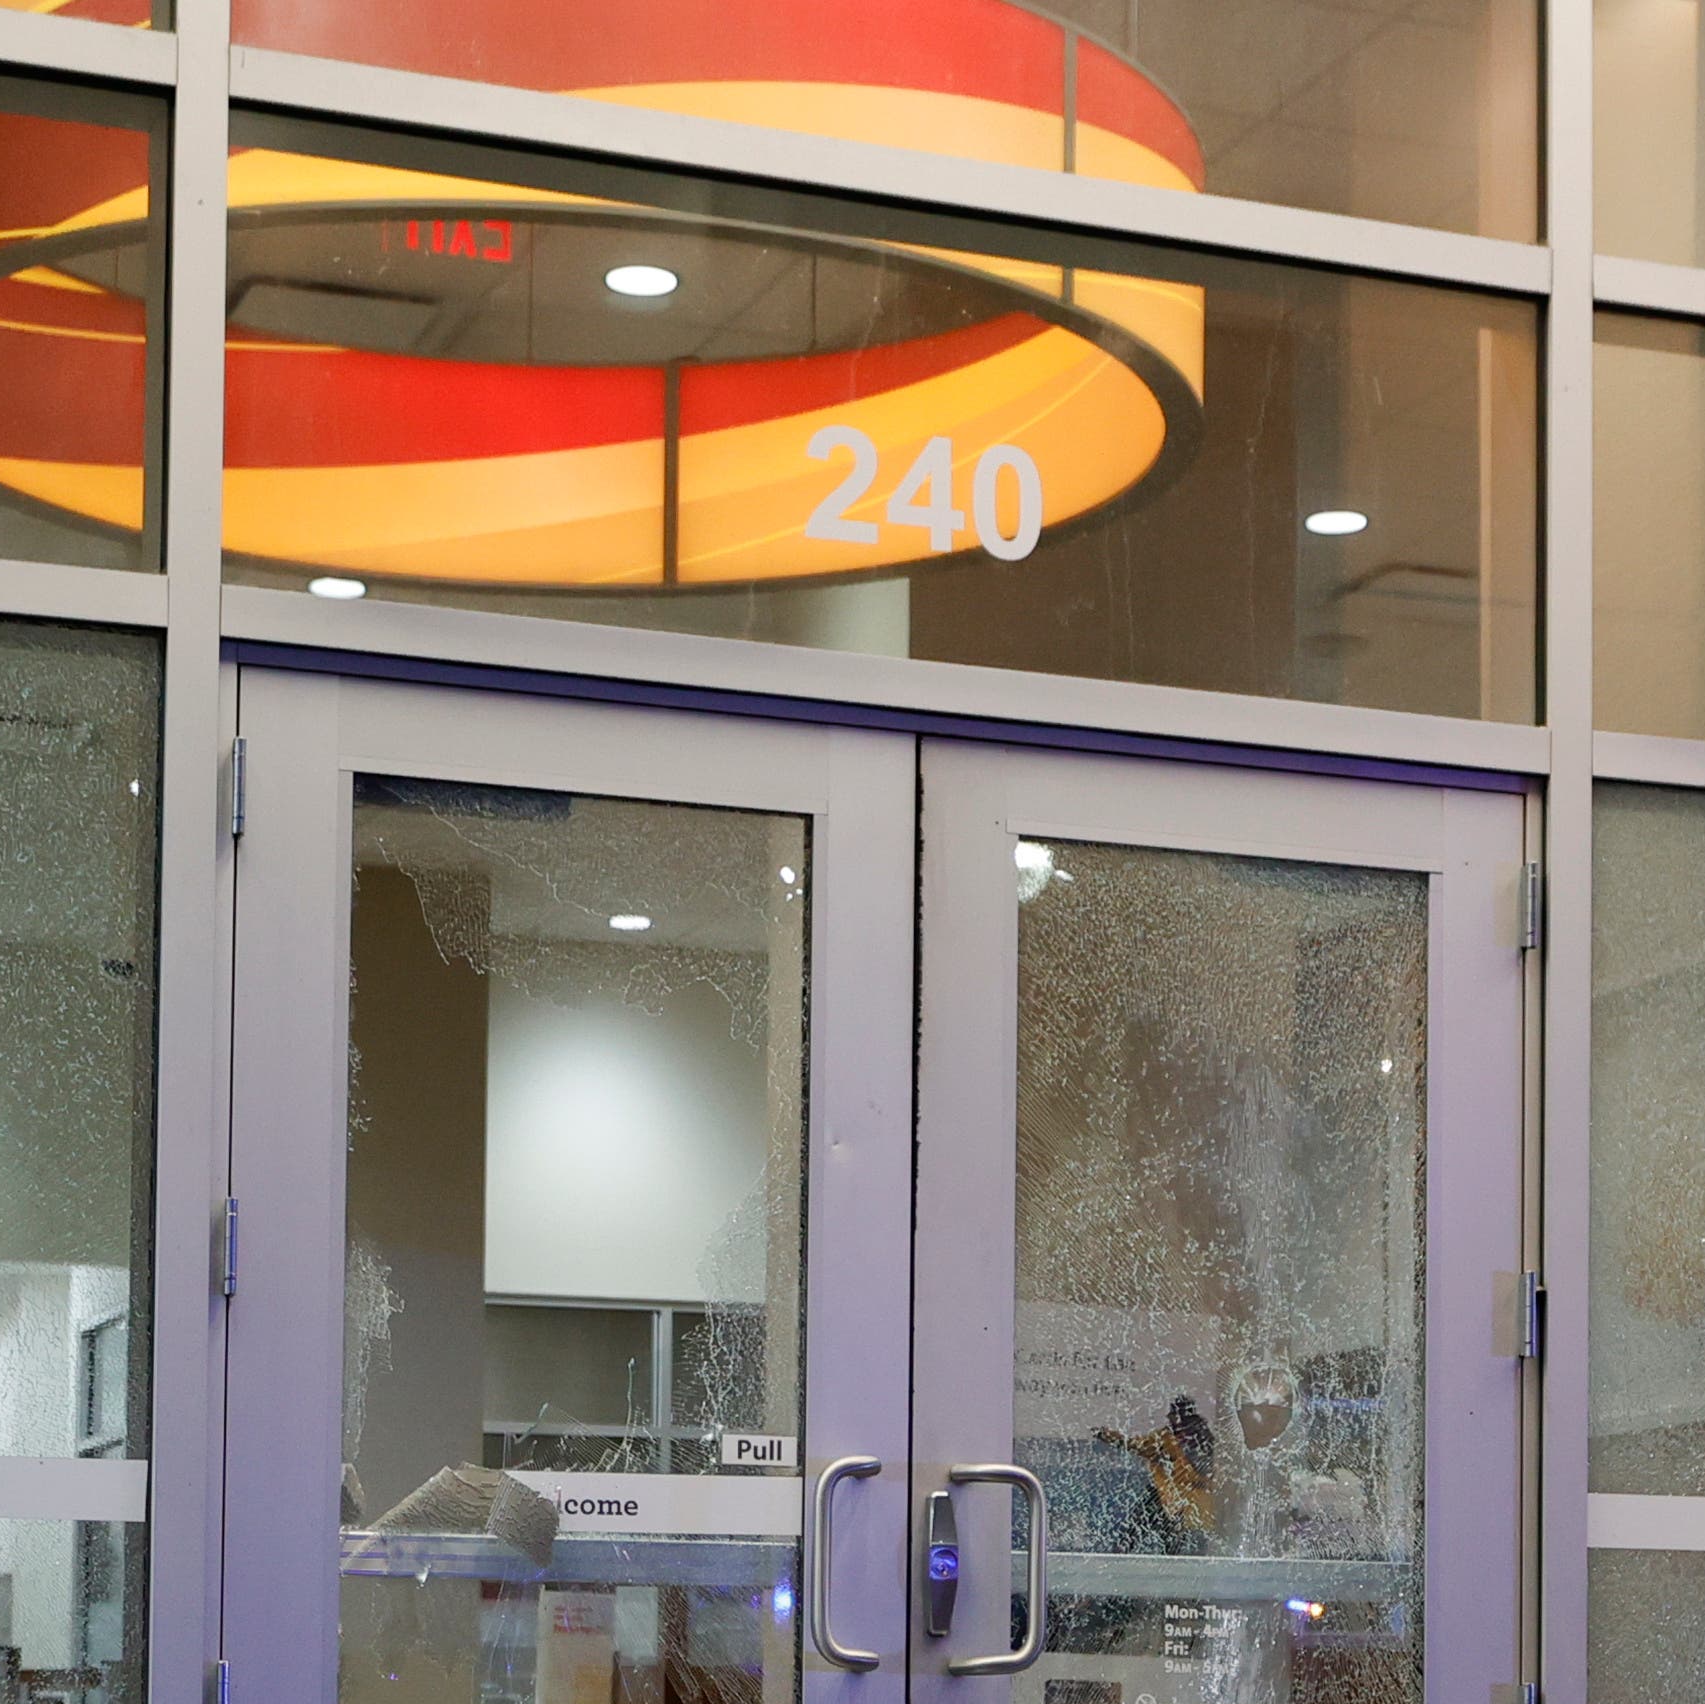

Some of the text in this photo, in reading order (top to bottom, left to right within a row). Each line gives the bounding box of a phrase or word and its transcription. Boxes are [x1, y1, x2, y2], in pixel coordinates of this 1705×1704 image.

[805, 425, 1043, 562] 240
[737, 1440, 782, 1461] Pull
[1164, 1623, 1192, 1637] 9AM
[1164, 1641, 1189, 1655] Fri:
[1164, 1660, 1192, 1673] 9AM
